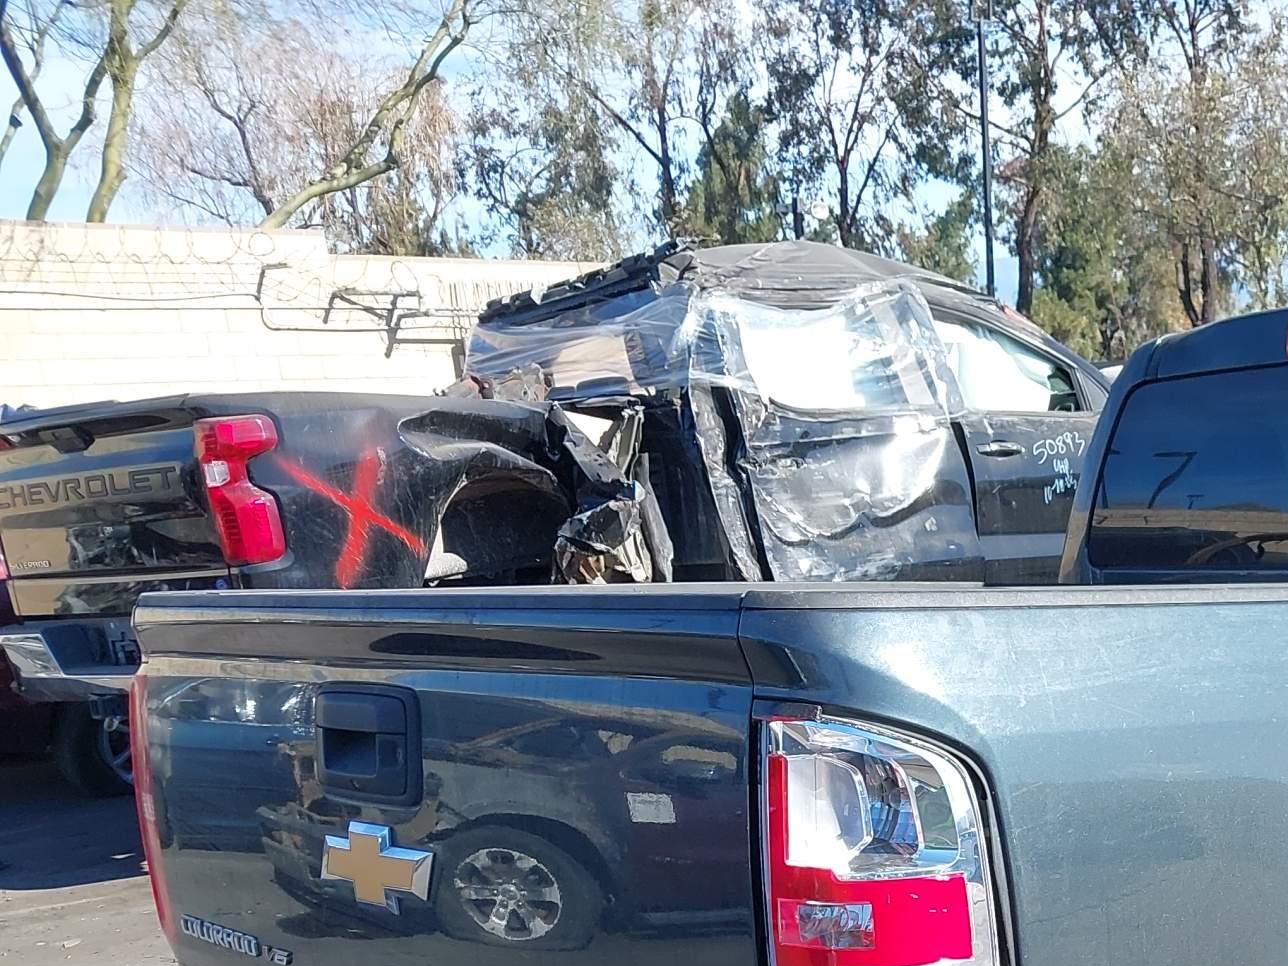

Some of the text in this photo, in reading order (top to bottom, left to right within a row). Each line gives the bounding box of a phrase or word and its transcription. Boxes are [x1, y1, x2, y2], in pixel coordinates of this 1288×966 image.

[1033, 432, 1085, 464] 50893
[180, 914, 293, 966] COLORADO V6
